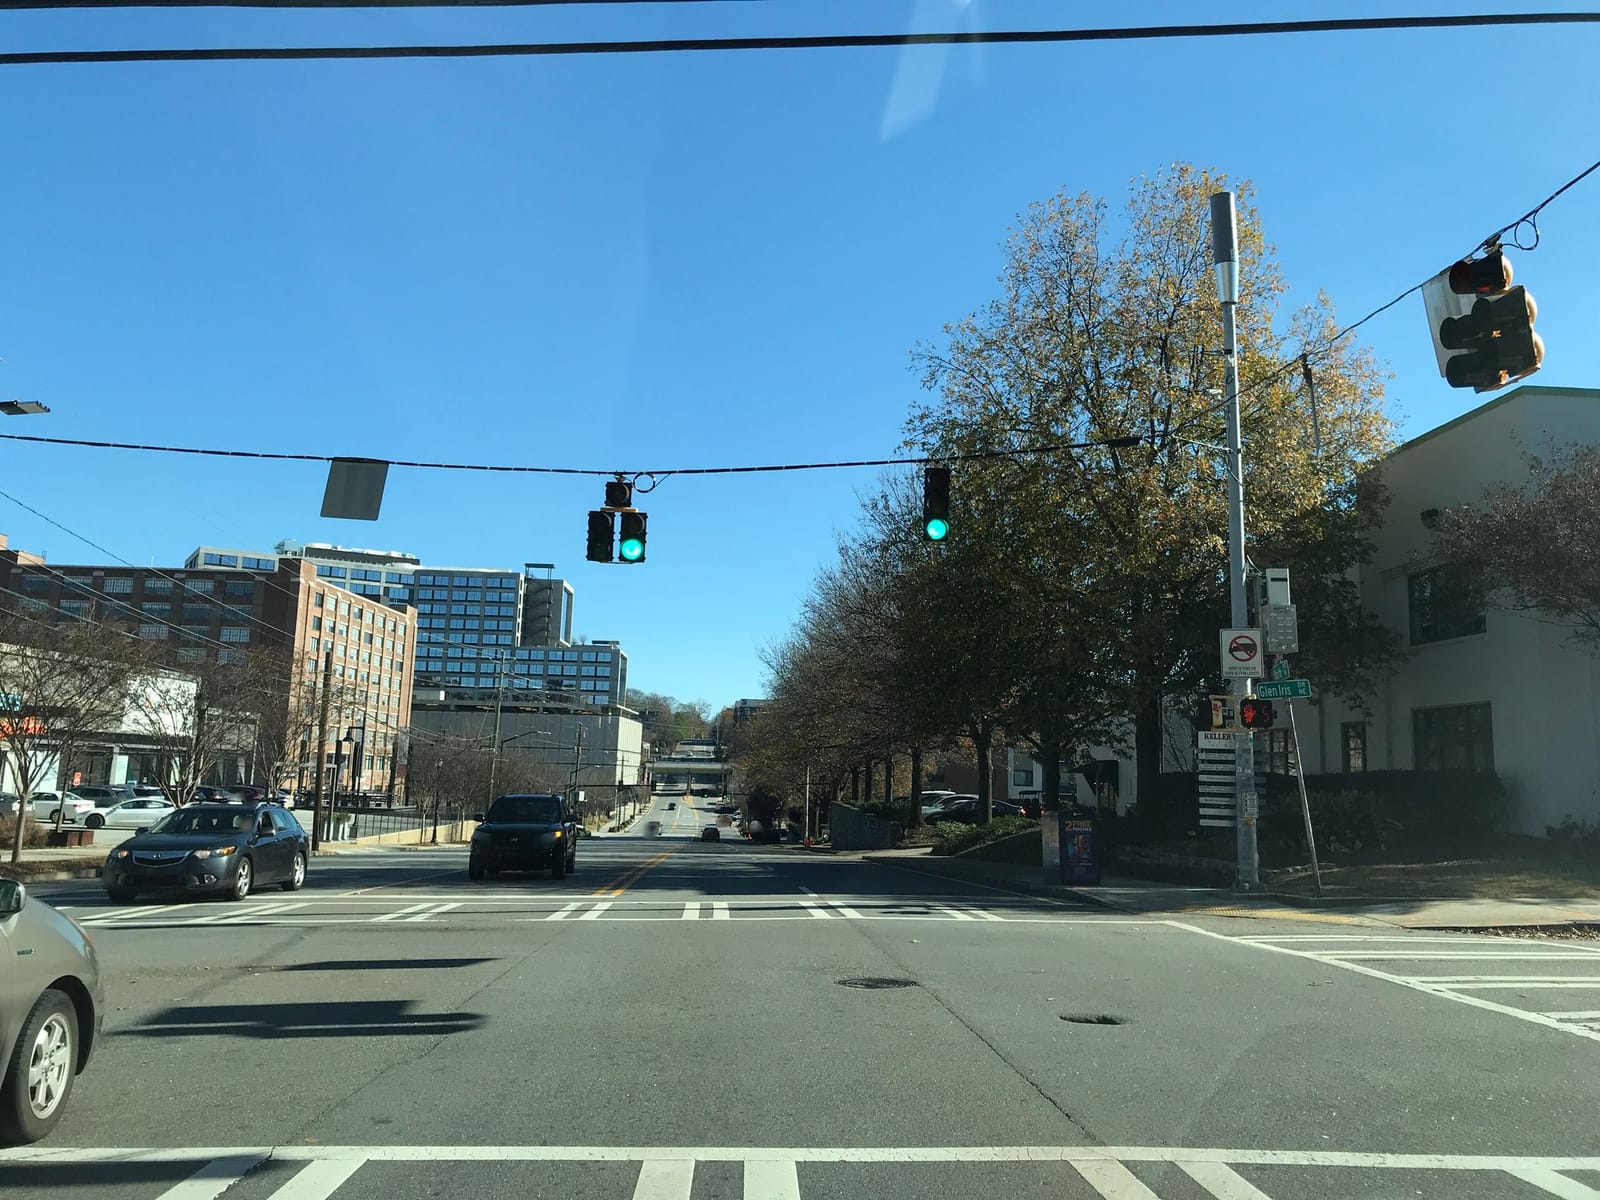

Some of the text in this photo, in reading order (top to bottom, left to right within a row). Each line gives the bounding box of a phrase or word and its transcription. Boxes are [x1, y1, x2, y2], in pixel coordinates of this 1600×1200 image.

[1259, 683, 1292, 697] Glen Iris
[1204, 732, 1232, 741] KELLER
[1064, 820, 1072, 832] 2
